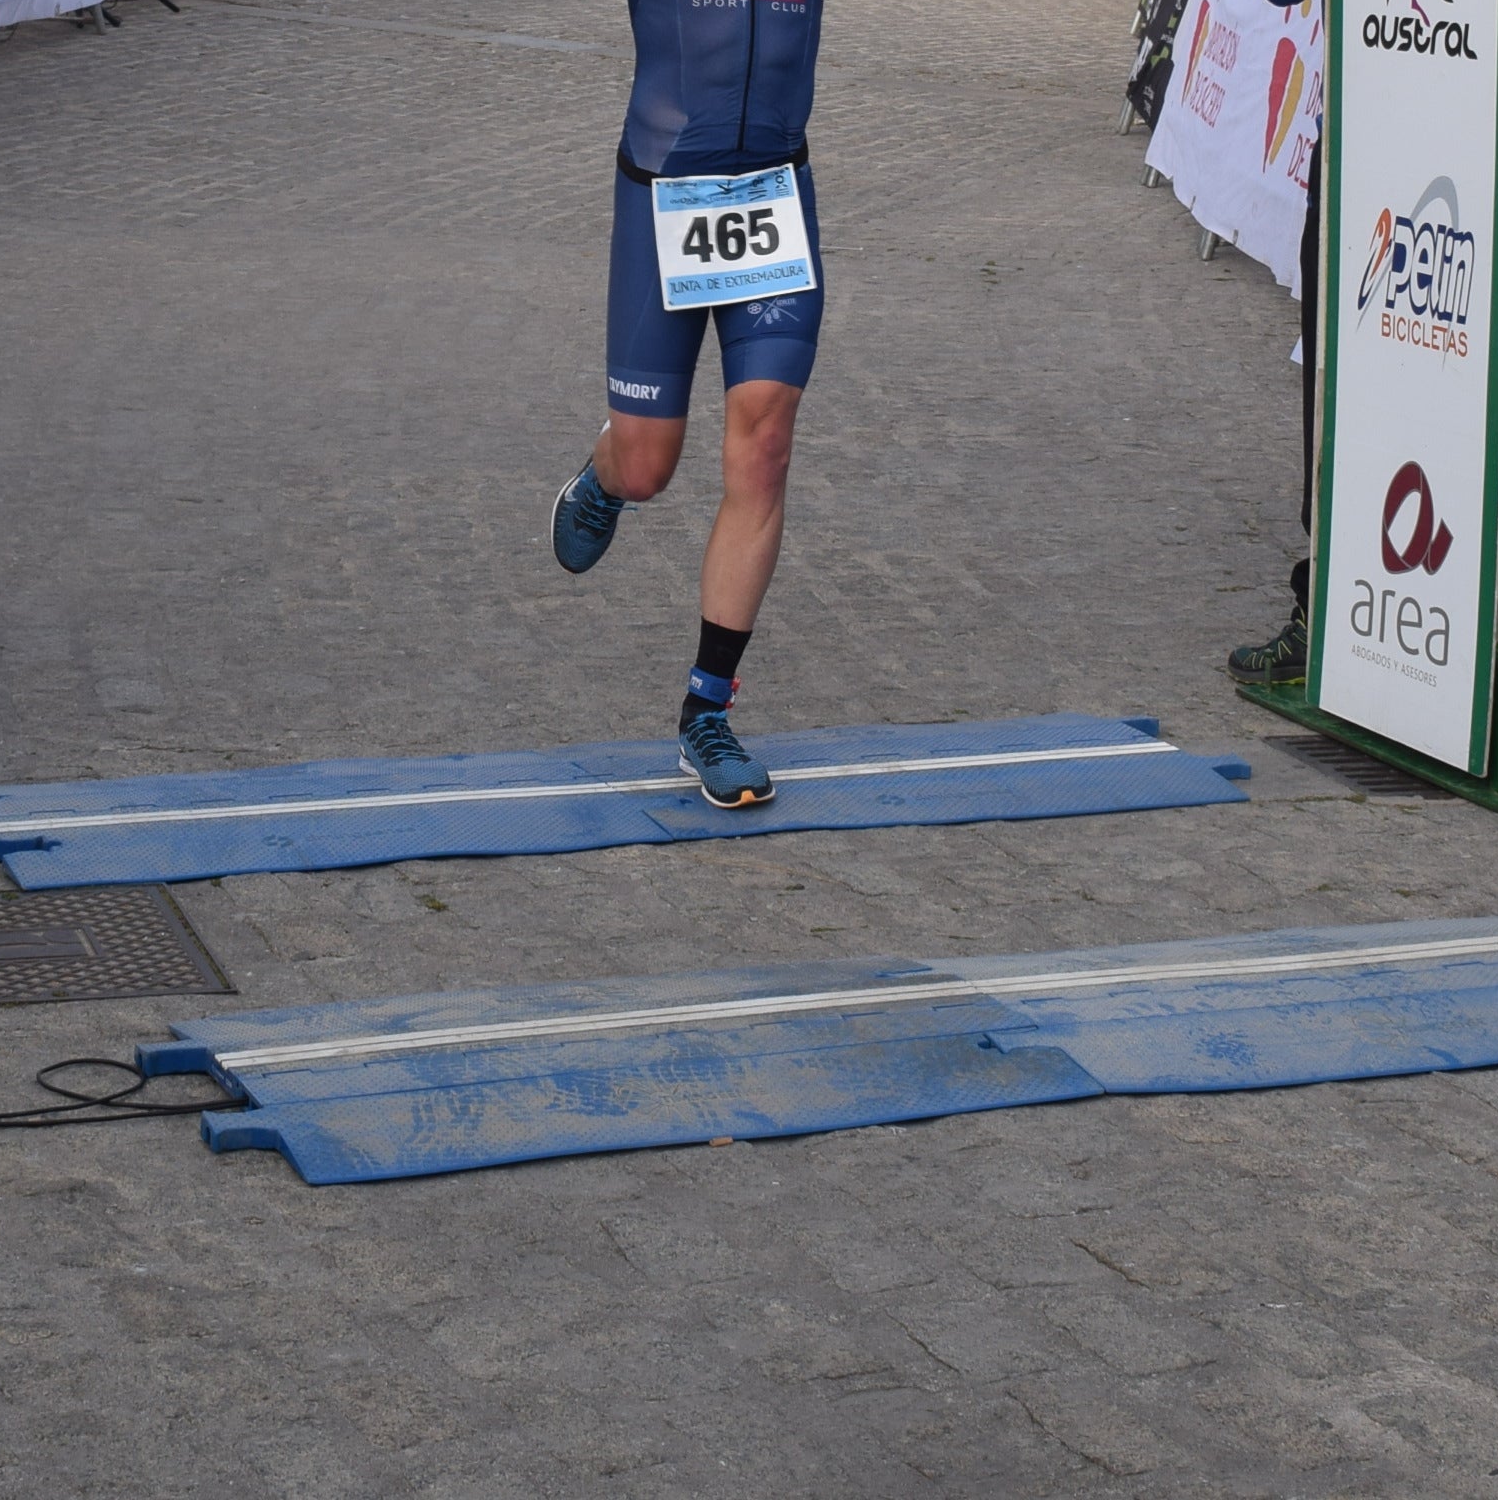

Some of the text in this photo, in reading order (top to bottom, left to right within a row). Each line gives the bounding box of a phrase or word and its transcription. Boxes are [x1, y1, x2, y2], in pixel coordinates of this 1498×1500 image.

[771, 0, 806, 14] CLUB
[1362, 13, 1479, 61] austral
[681, 207, 781, 263] 465
[669, 265, 806, 296] JUNTA DE EXTREMADURA
[1383, 215, 1475, 326] Pelin
[1380, 312, 1469, 358] BICICLETAS
[1350, 579, 1451, 667] area
[1351, 644, 1438, 689] ABOGADOS Y ASESORES
